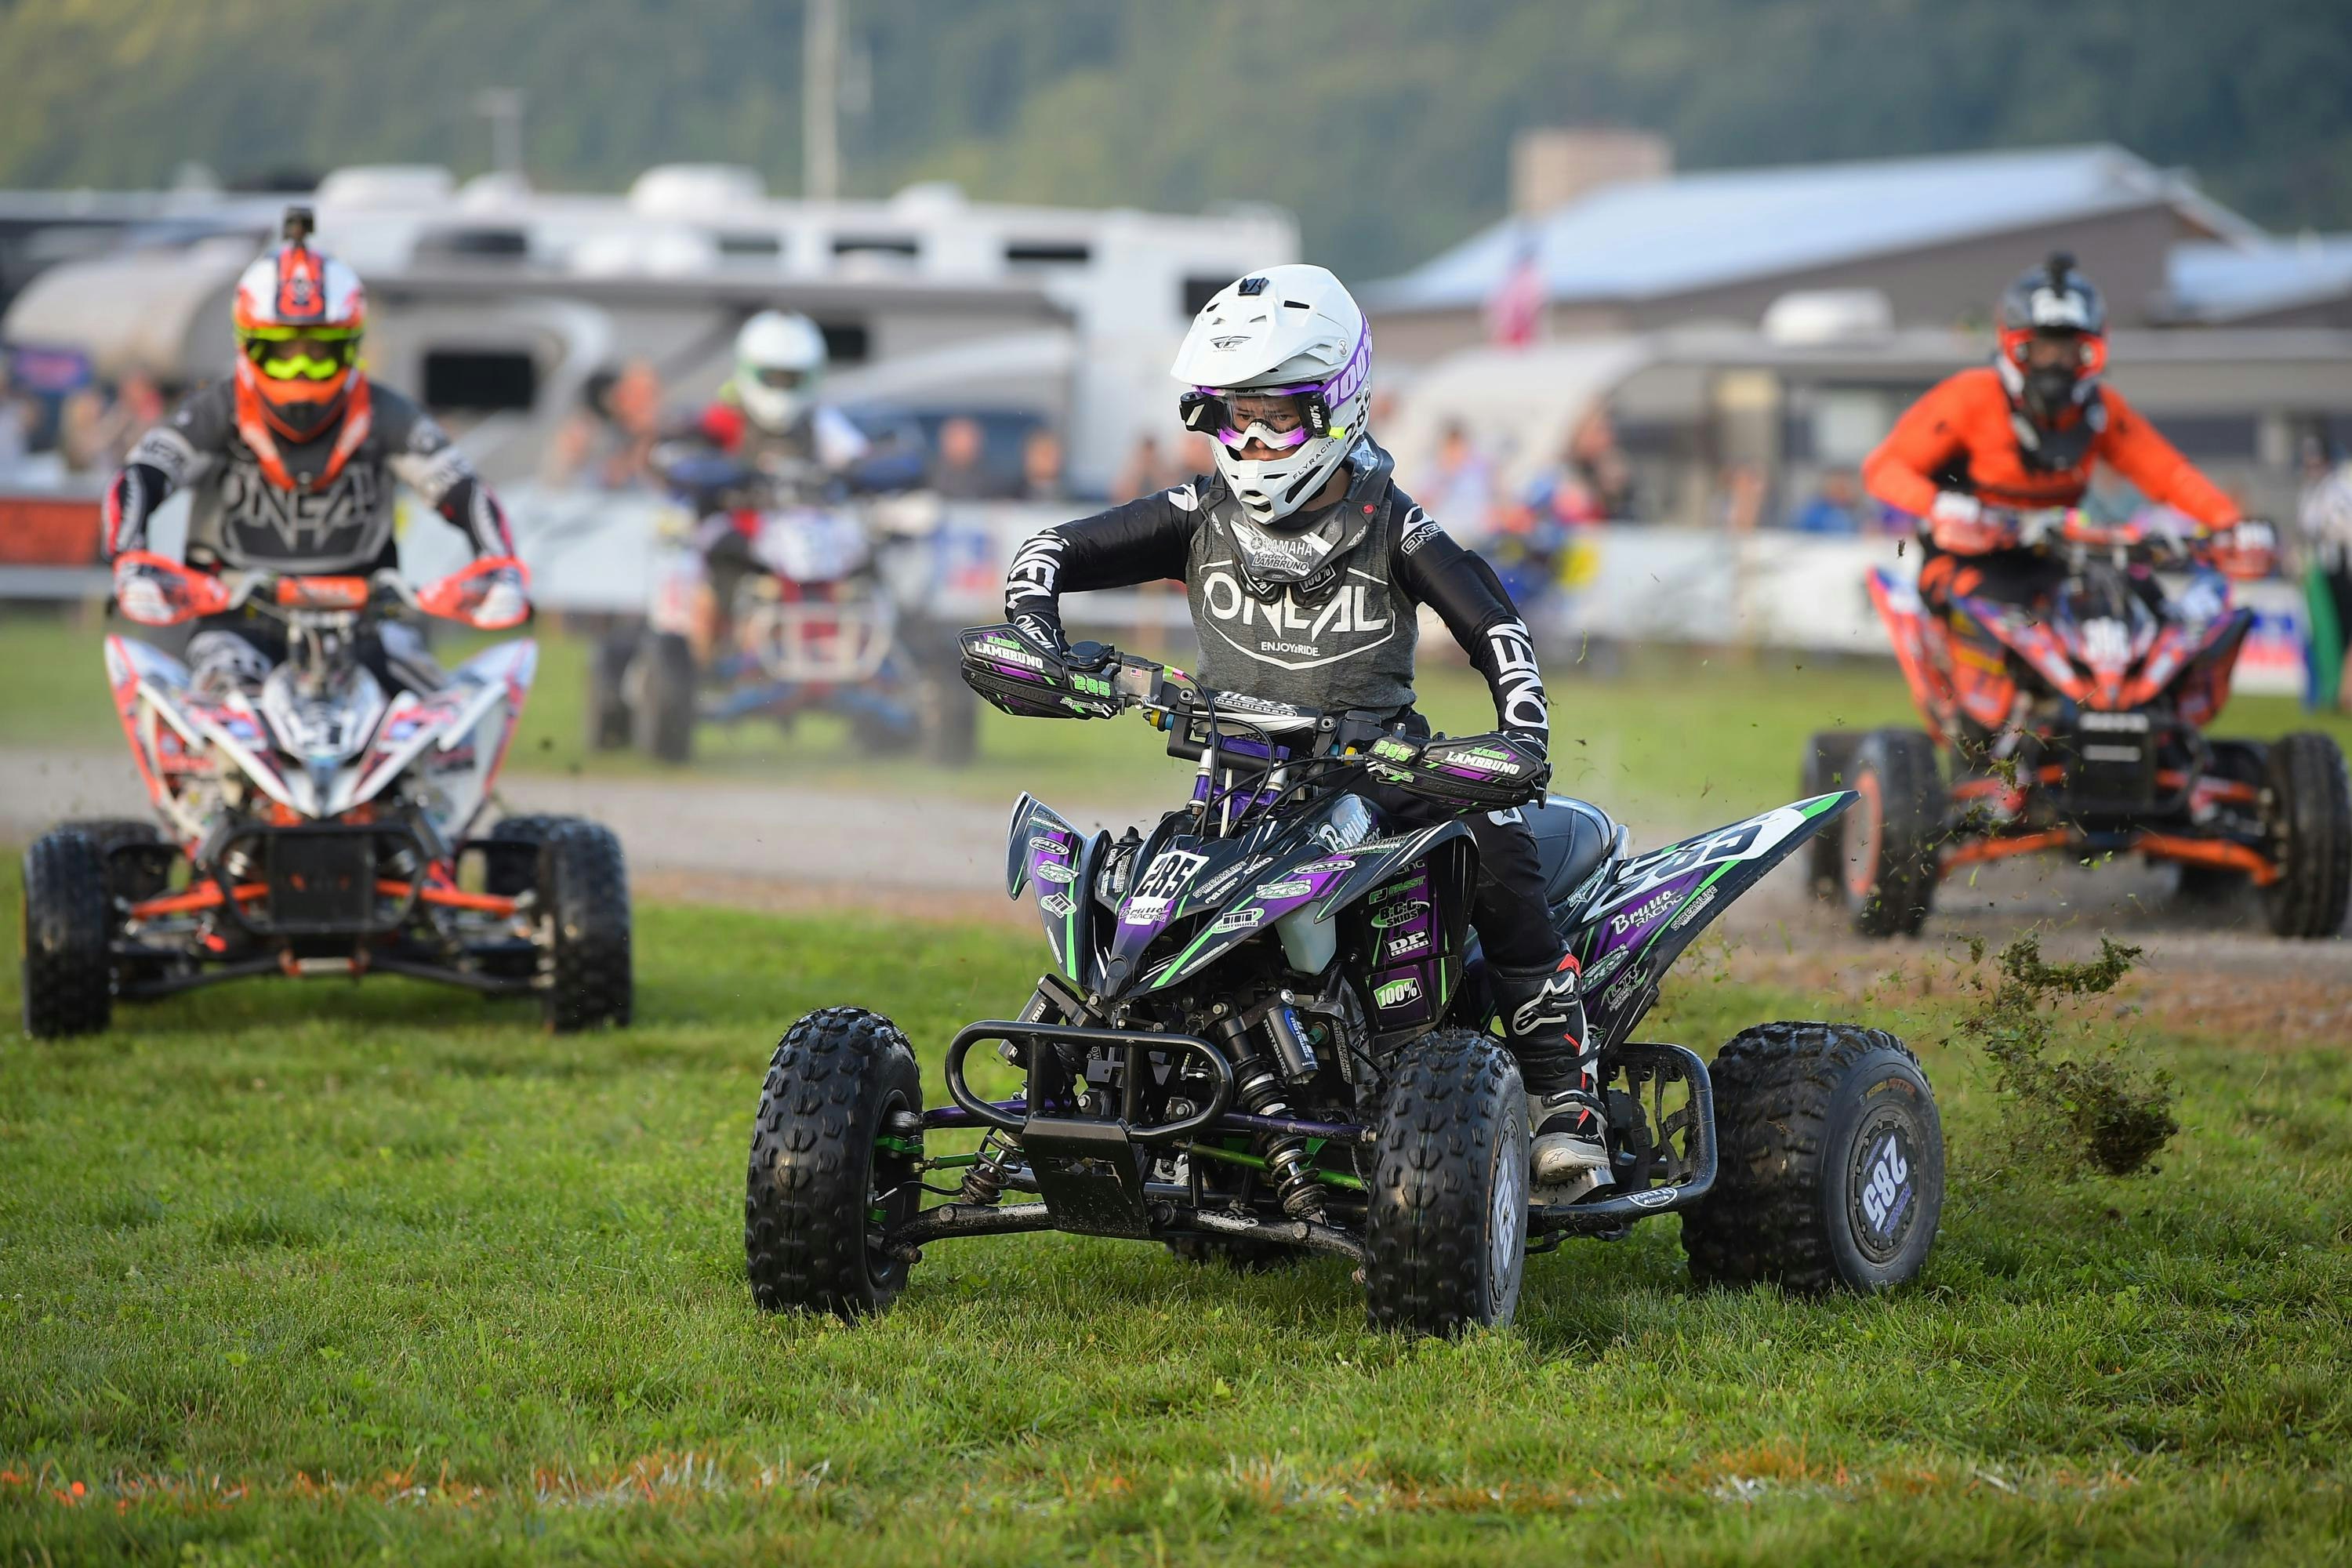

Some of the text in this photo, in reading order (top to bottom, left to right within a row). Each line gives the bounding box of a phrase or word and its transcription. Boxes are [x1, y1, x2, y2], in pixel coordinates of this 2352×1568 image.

[1308, 405, 1324, 430] 100%
[1292, 437, 1338, 481] FLYRACIN
[1254, 550, 1288, 561] Kaden
[1264, 539, 1313, 557] YAMAHA
[1252, 557, 1312, 572] LAMBRUNO
[974, 641, 1044, 670] LAMBRUNO
[1074, 675, 1112, 697] 285
[1216, 699, 1294, 717] handlebars
[1374, 739, 1412, 762] 285
[1444, 751, 1520, 775] LAMBRUNO
[1134, 854, 1198, 899] 285
[1192, 860, 1247, 899] STREAMLINE
[1388, 875, 1426, 894] FASST
[1129, 912, 1167, 922] RACING
[1387, 910, 1418, 927] SKIDS
[1670, 885, 1719, 931] STREAMLINE
[1388, 931, 1426, 951] DP
[1378, 981, 1417, 1007] 100%
[1863, 1134, 1908, 1233] 285
[1495, 1157, 1517, 1269] 285
